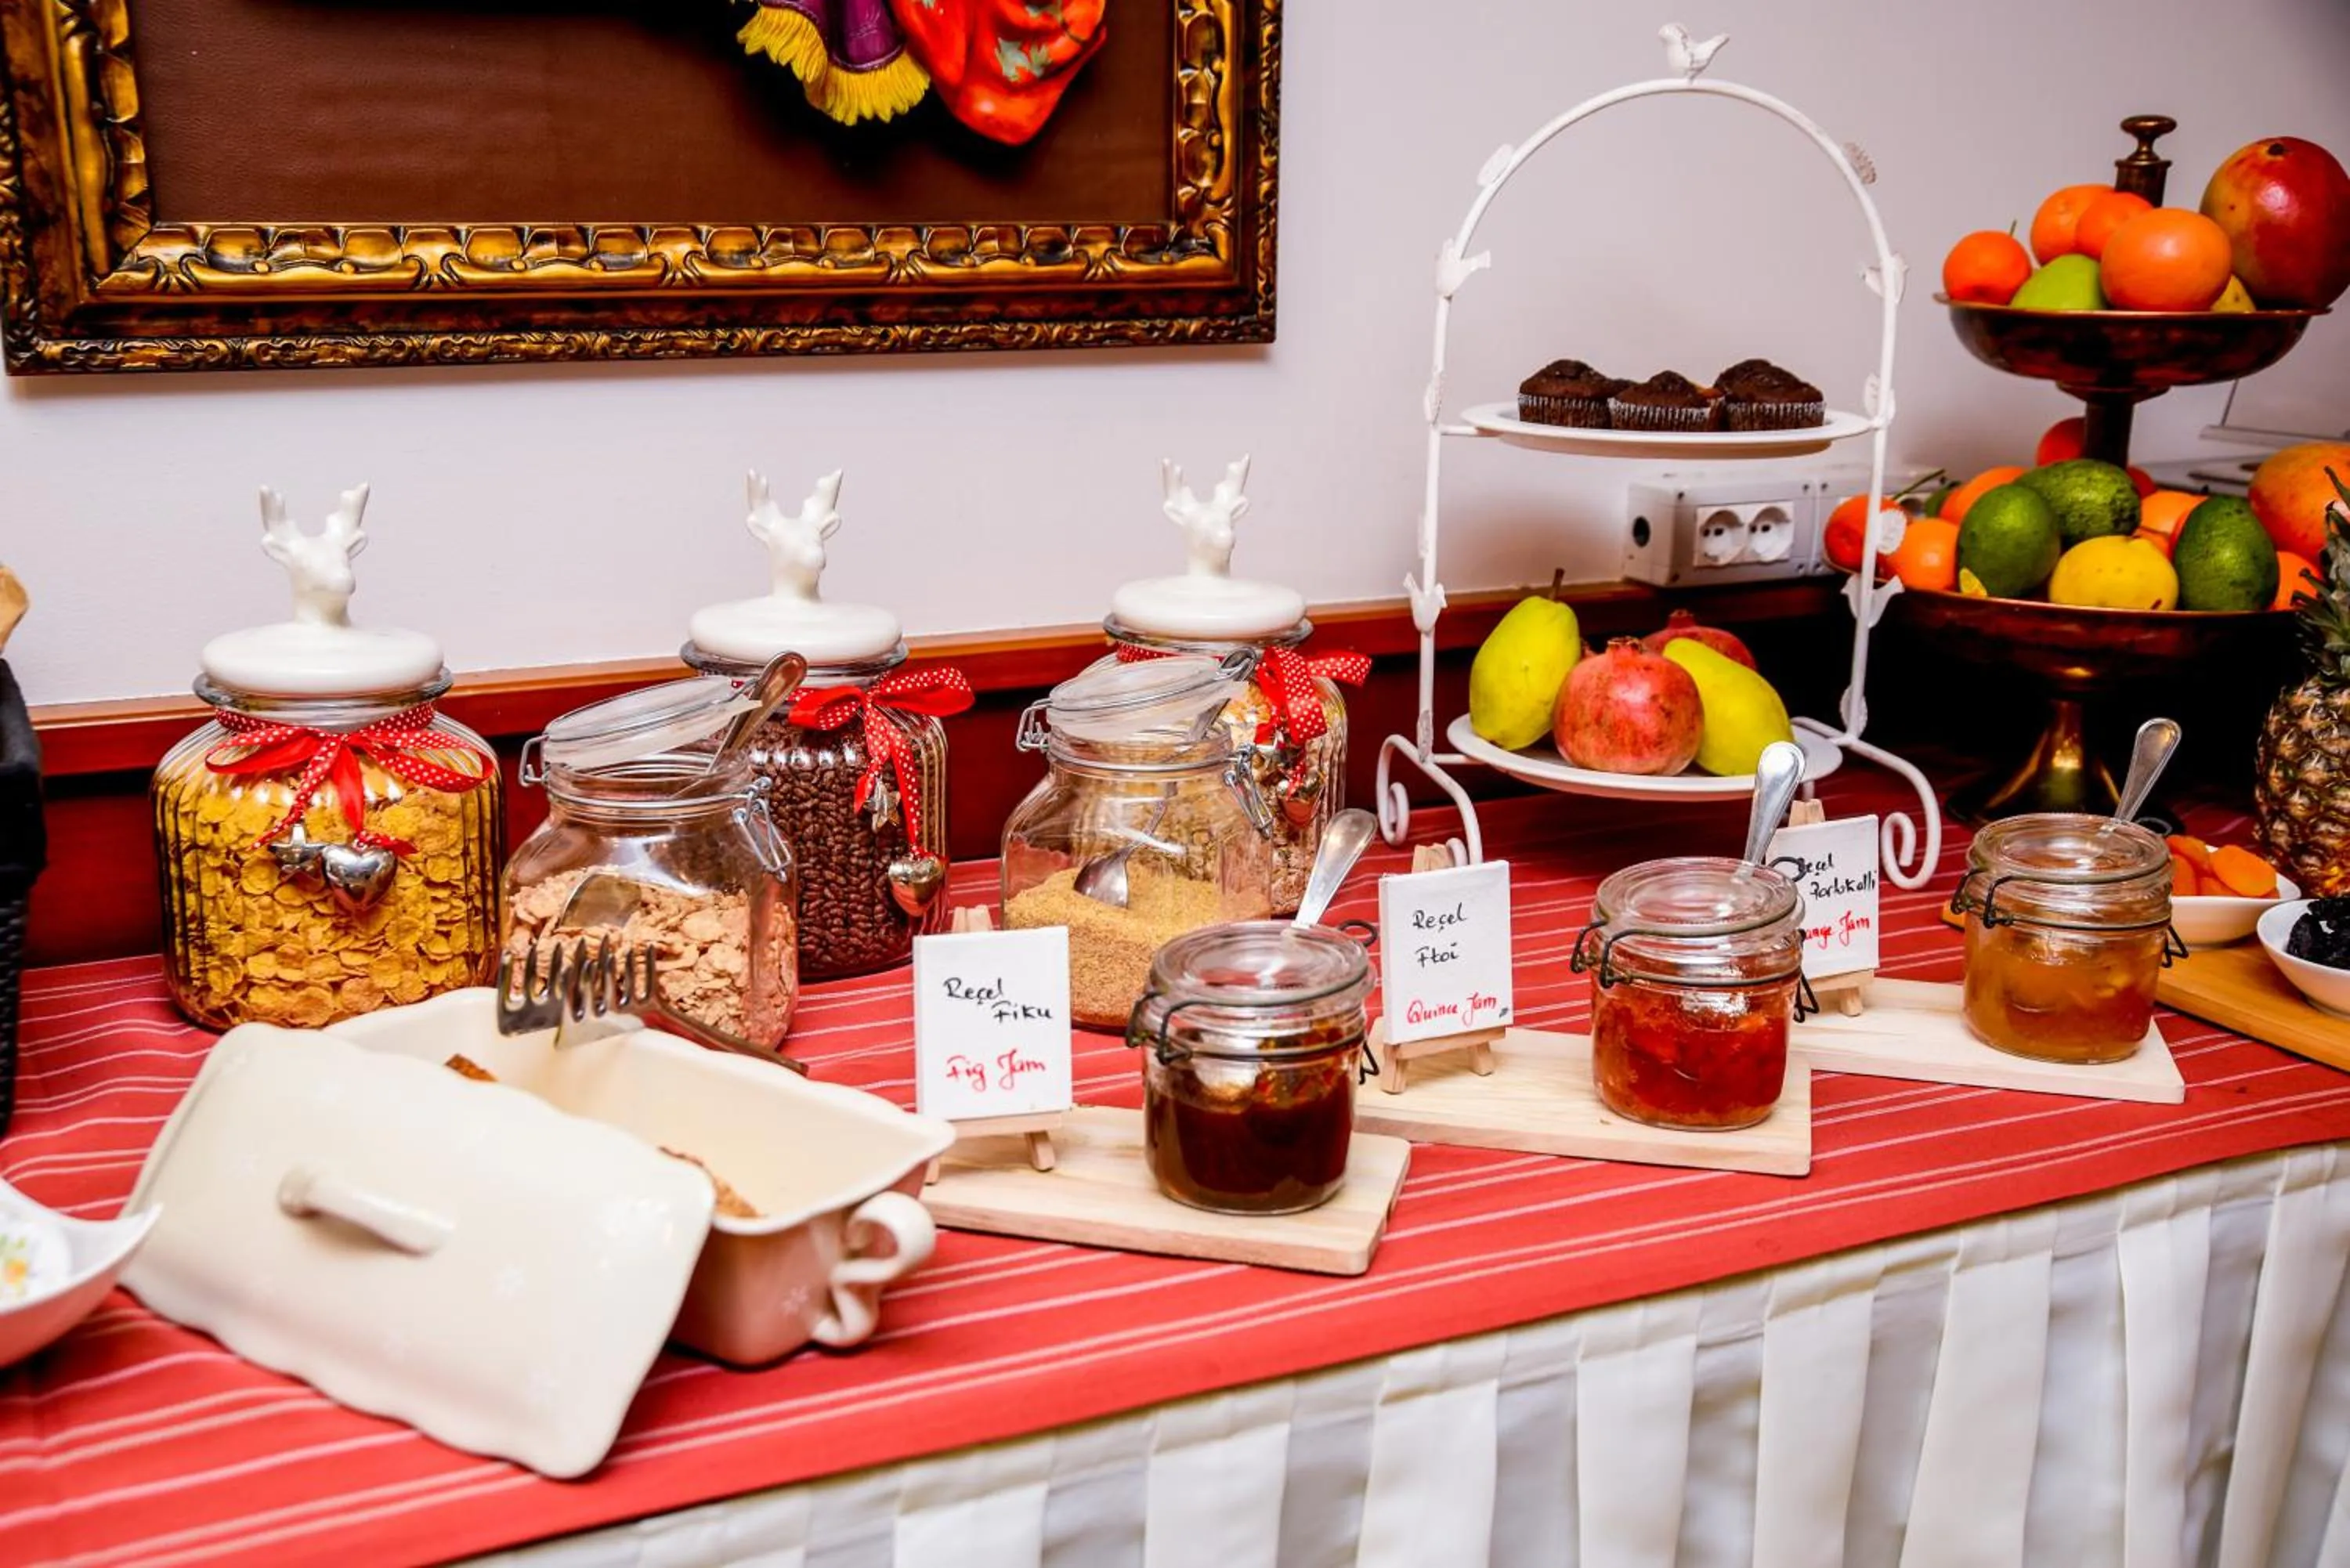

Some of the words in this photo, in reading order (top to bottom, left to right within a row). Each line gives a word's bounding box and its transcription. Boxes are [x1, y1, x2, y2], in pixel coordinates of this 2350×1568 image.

[1798, 853, 1834, 876] eçel
[1413, 902, 1467, 931] Reçel
[1805, 925, 1831, 949] ange
[1838, 910, 1870, 946] Jam
[943, 977, 1003, 1005] Reçel
[1407, 999, 1458, 1024] Quince
[1462, 992, 1497, 1027] Jam
[946, 1055, 986, 1092] Fig
[997, 1050, 1046, 1089] Jam
